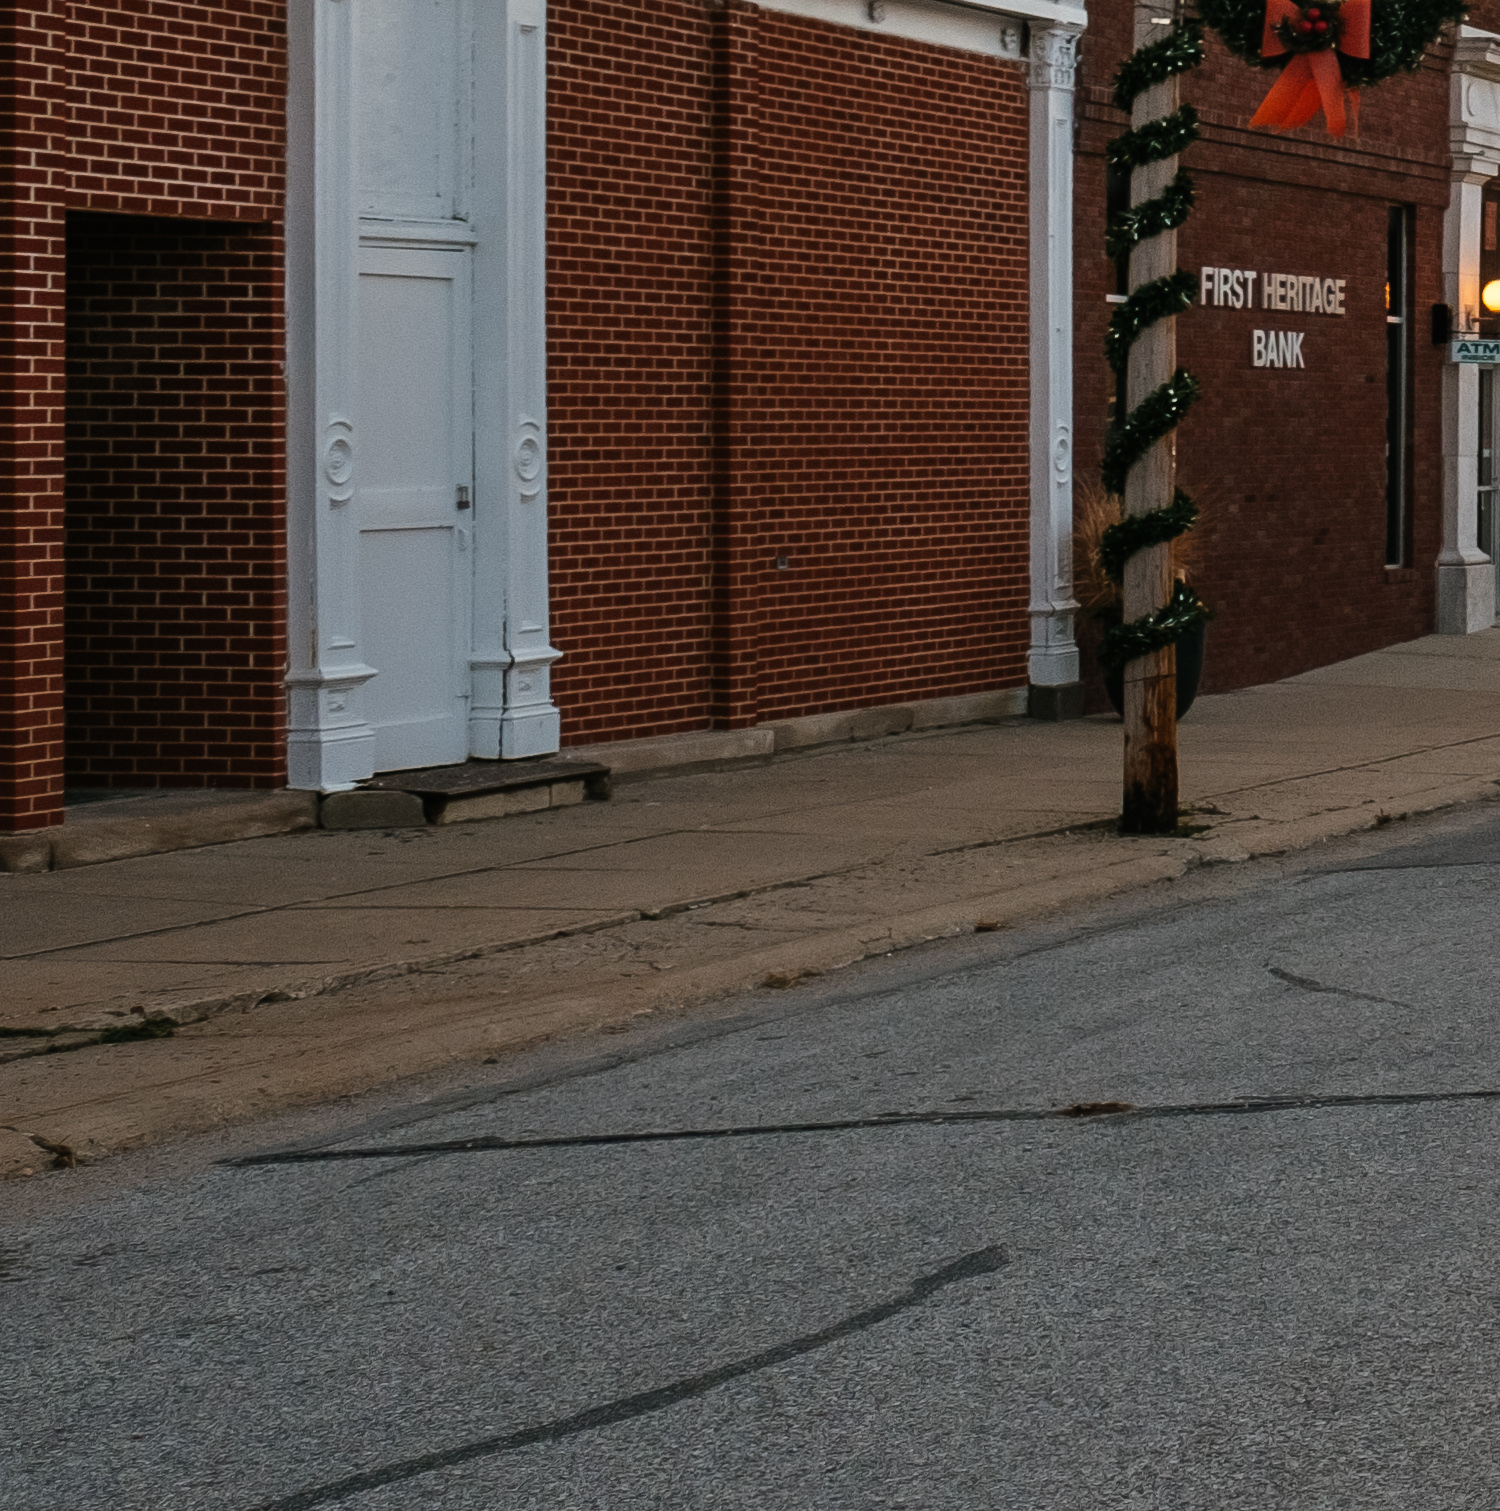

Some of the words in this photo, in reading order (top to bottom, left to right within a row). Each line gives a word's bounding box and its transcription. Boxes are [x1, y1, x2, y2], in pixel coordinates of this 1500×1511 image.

[1200, 266, 1258, 309] FIRST
[1261, 272, 1347, 315] HERITAGE
[1252, 329, 1306, 369] BANK
[1456, 342, 1500, 355] ATM
